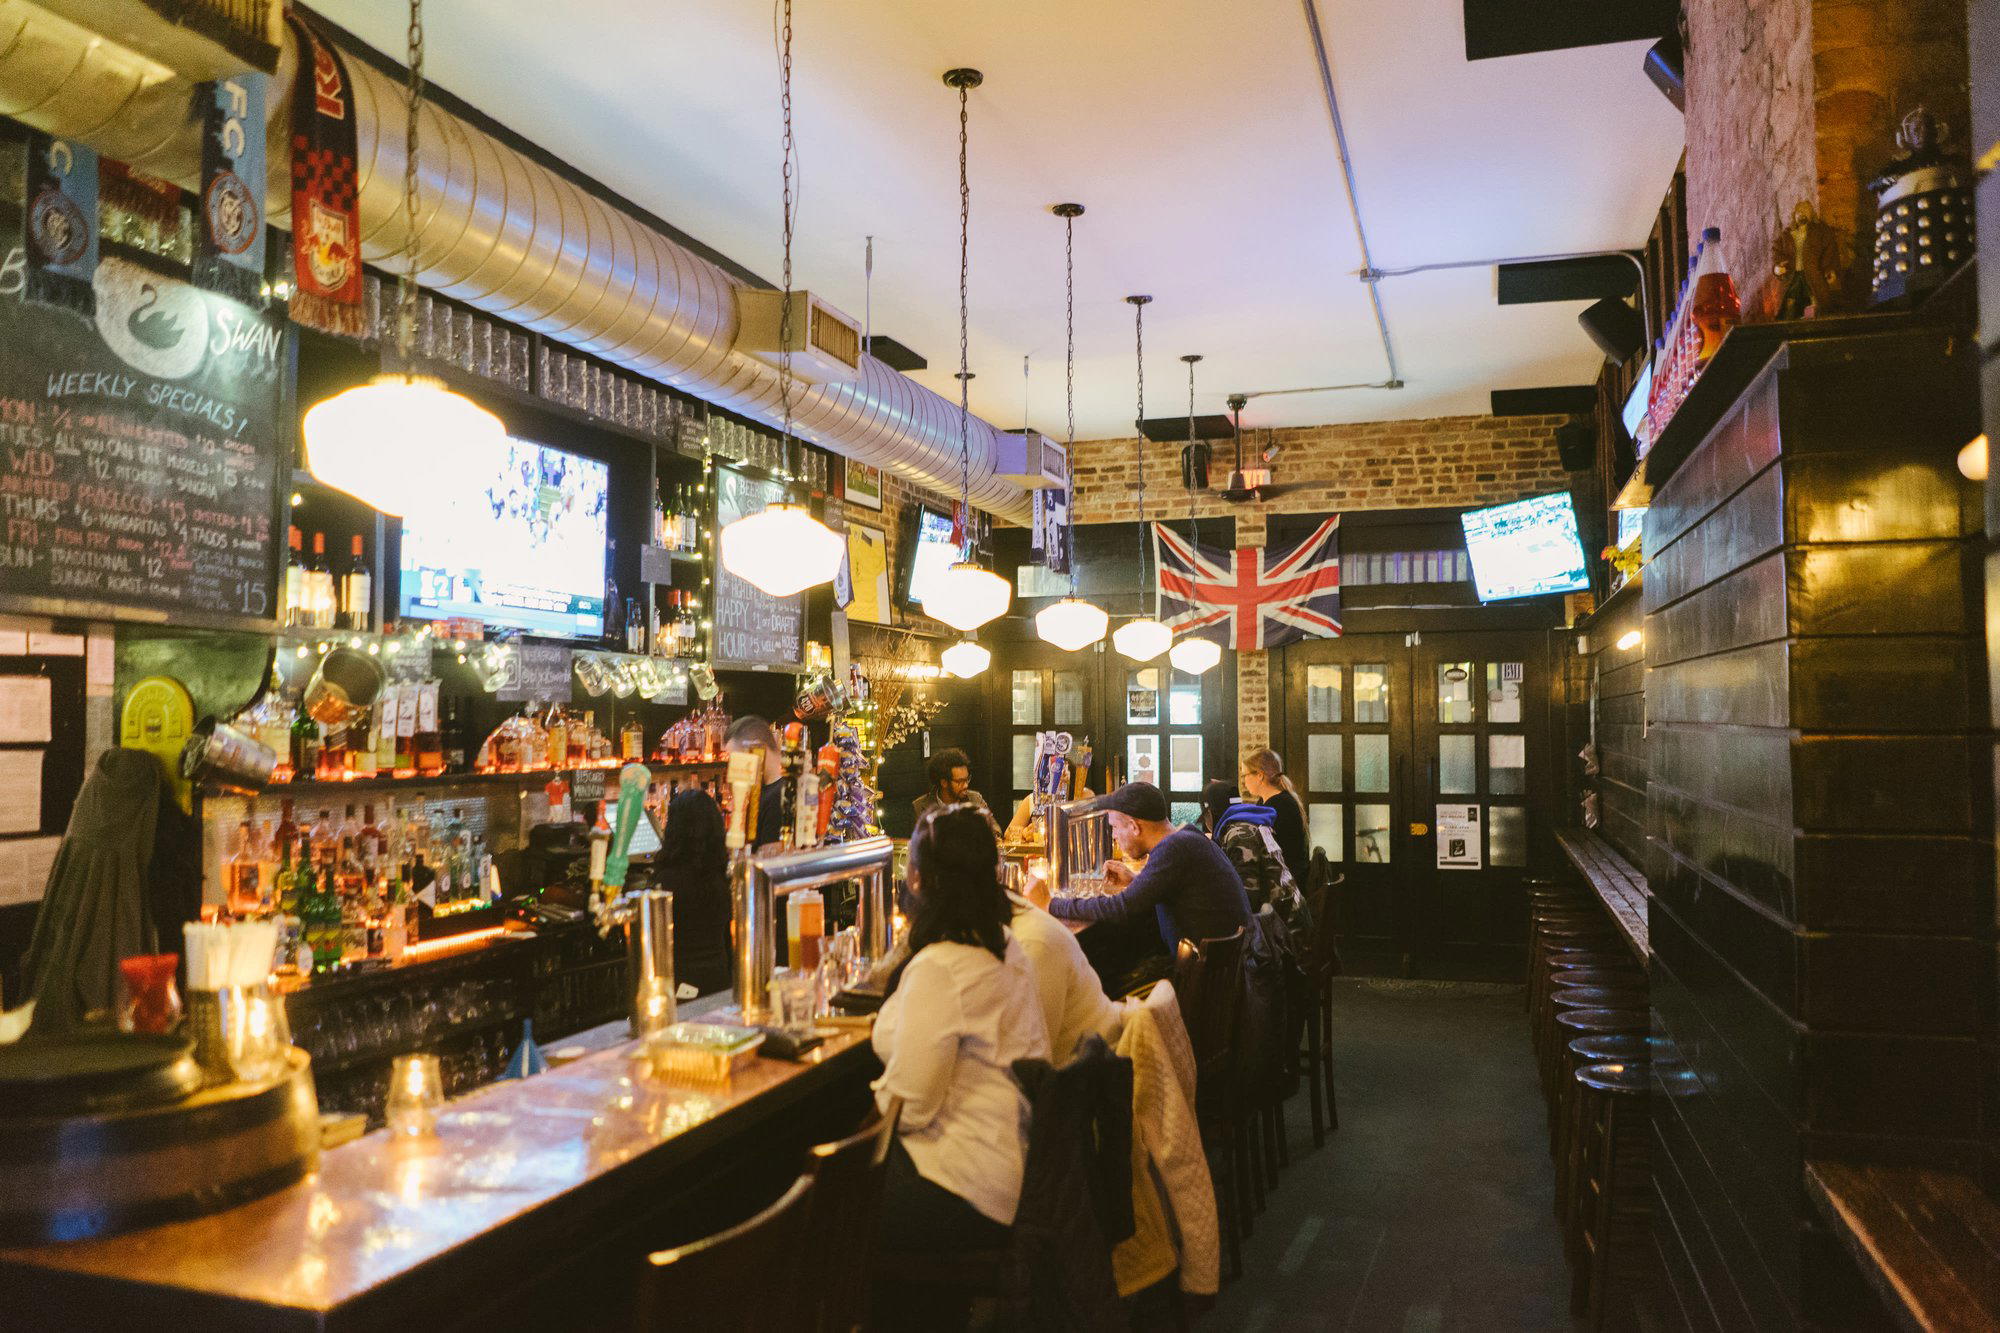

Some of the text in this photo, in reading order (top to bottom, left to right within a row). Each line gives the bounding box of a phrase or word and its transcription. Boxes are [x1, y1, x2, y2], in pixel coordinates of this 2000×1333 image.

[210, 307, 283, 362] SWAN
[47, 371, 137, 399] WEEKLY
[191, 526, 228, 549] TACOS
[235, 580, 267, 615] $15
[716, 597, 749, 631] HAPPY
[771, 614, 796, 634] DRAFT
[718, 632, 747, 659] HOUR
[783, 649, 798, 662] WINE
